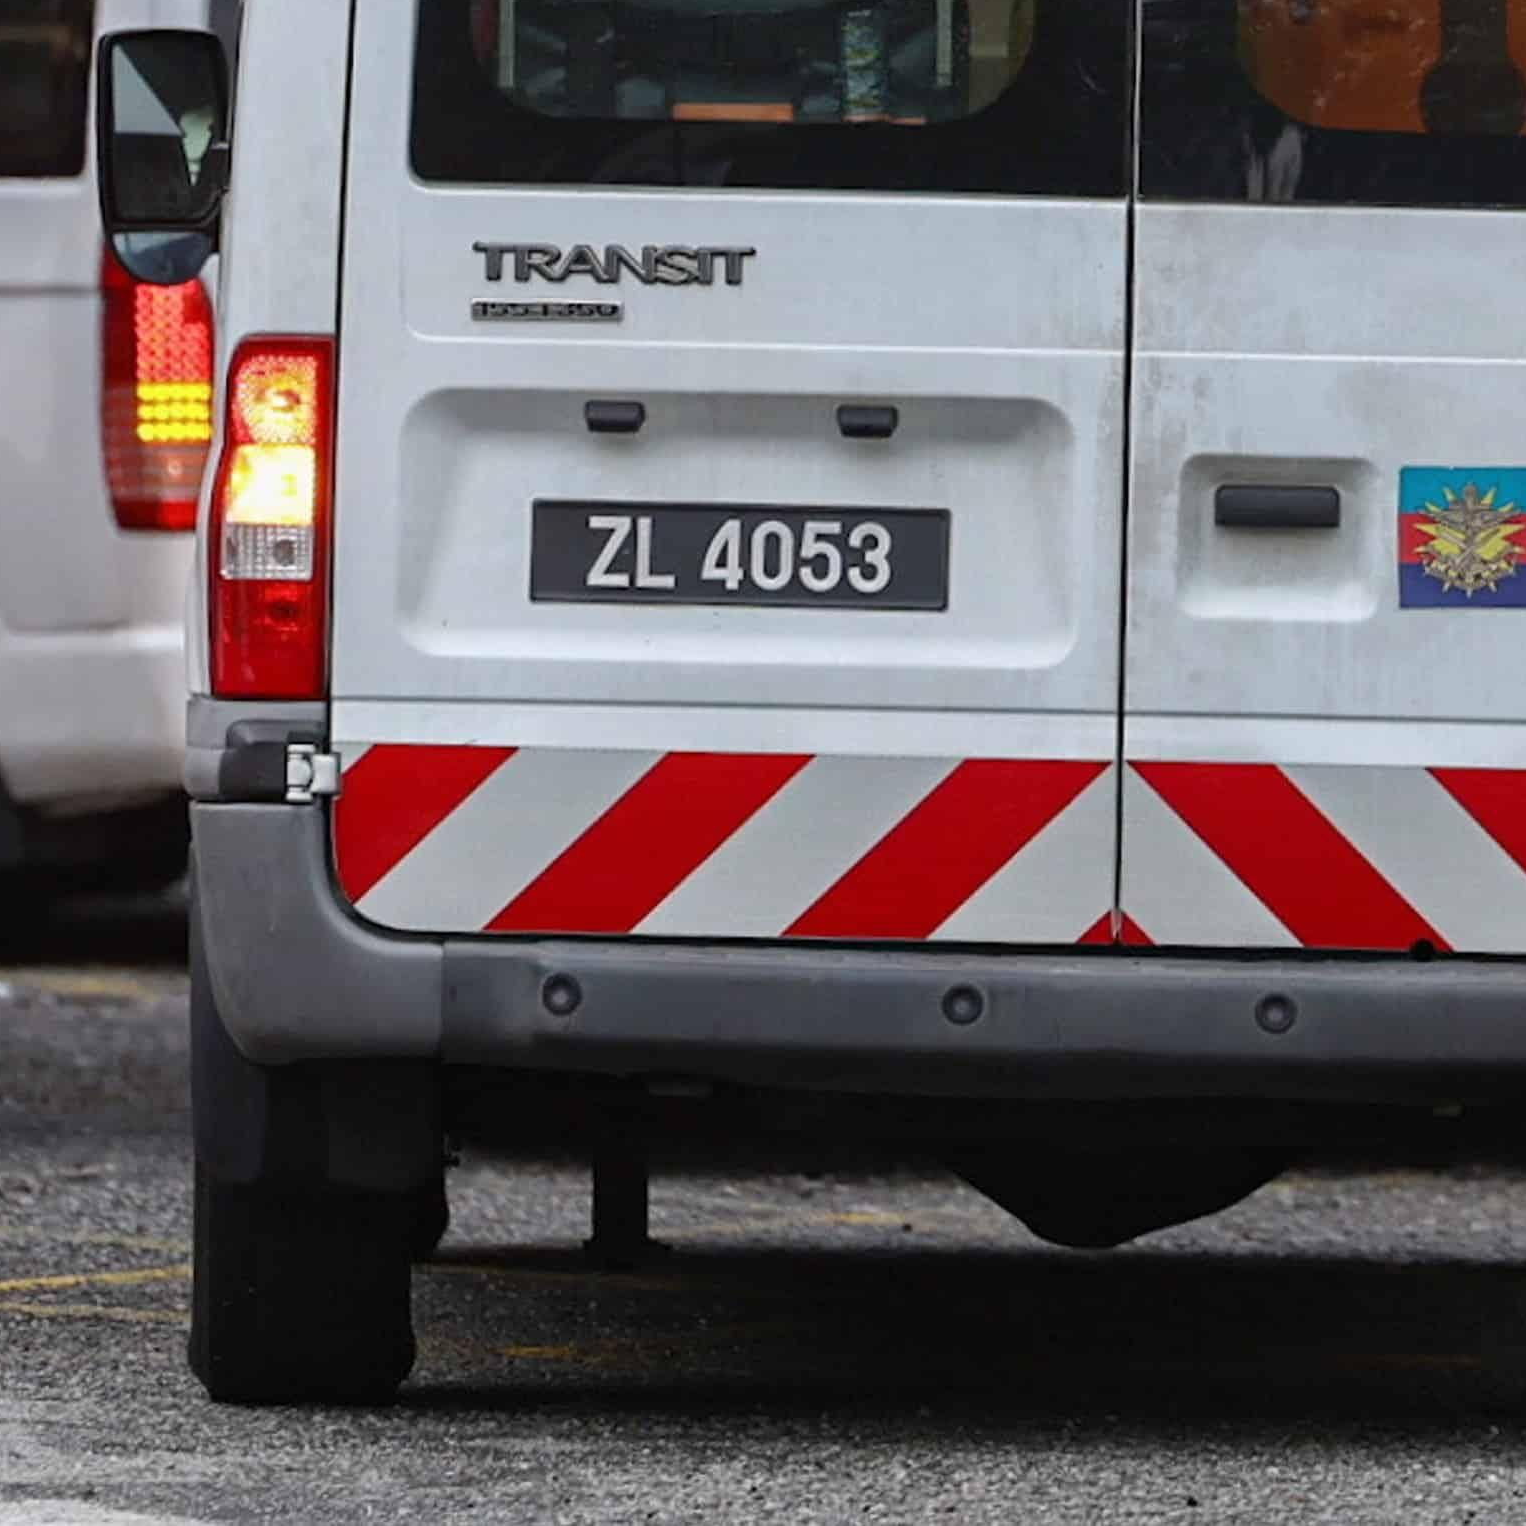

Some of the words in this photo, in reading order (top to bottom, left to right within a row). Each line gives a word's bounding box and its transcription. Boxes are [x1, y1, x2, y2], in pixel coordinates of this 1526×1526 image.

[472, 241, 757, 286] TRANSIT
[585, 515, 676, 589] ZL
[700, 518, 893, 593] 4053
